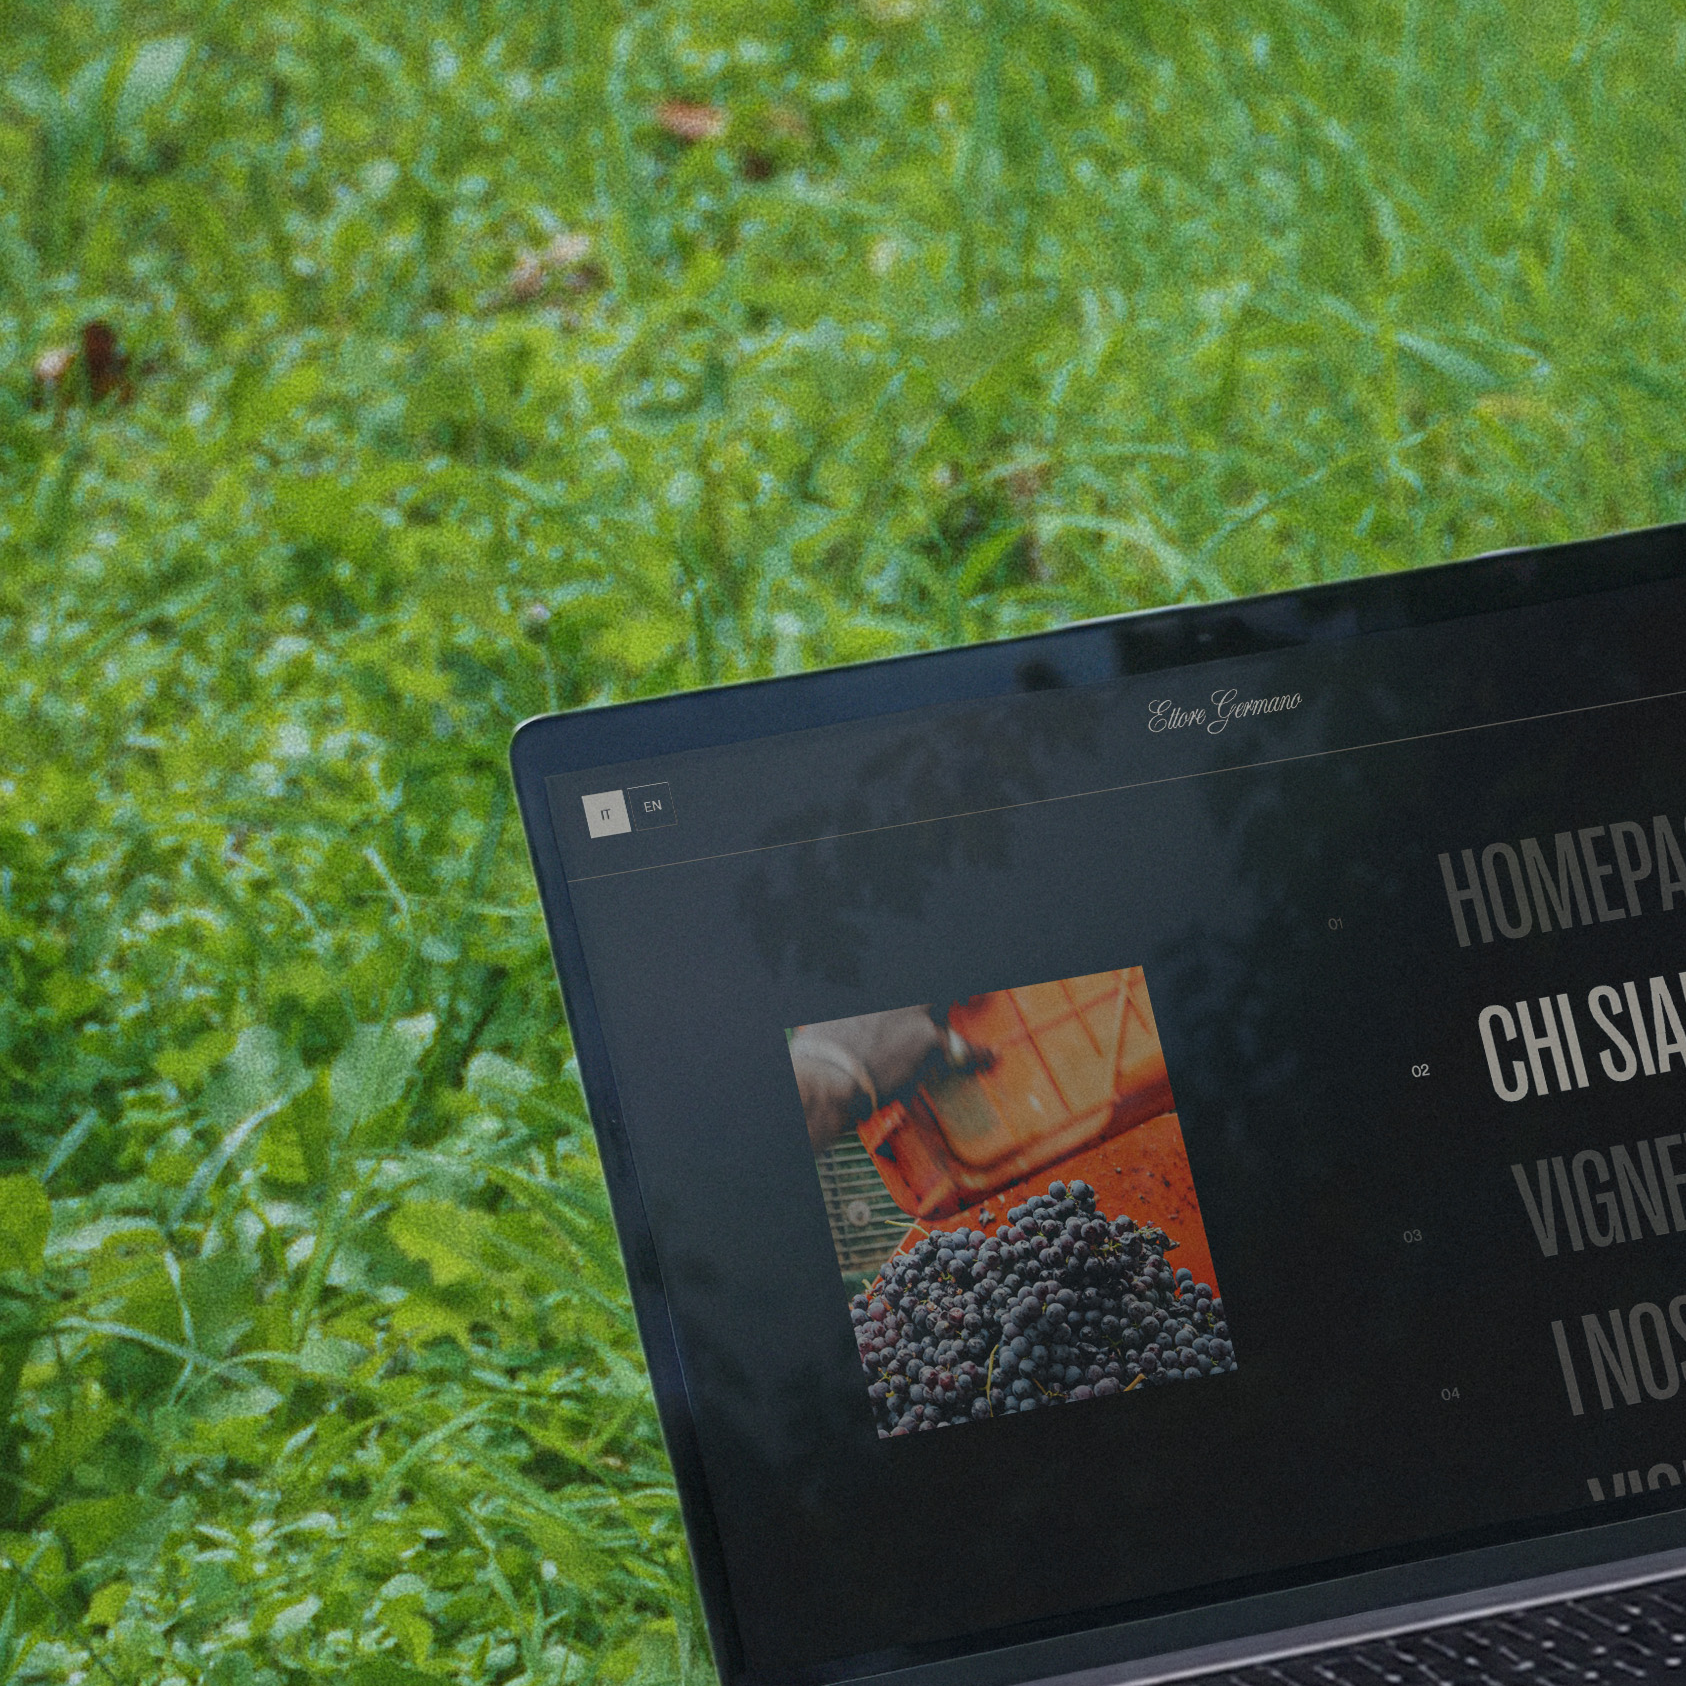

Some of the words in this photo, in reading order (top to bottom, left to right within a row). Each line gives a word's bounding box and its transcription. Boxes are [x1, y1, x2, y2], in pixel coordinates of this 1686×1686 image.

[1147, 699, 1206, 733] Ettore
[1206, 688, 1303, 735] Germano
[643, 799, 662, 813] EN
[600, 808, 611, 820] IT
[1328, 917, 1343, 930] 01
[1478, 993, 1589, 1102] CHI
[1412, 1063, 1431, 1078] 02
[1403, 1229, 1422, 1243] 03
[1551, 1319, 1584, 1416] I
[1441, 1387, 1461, 1401] 04
